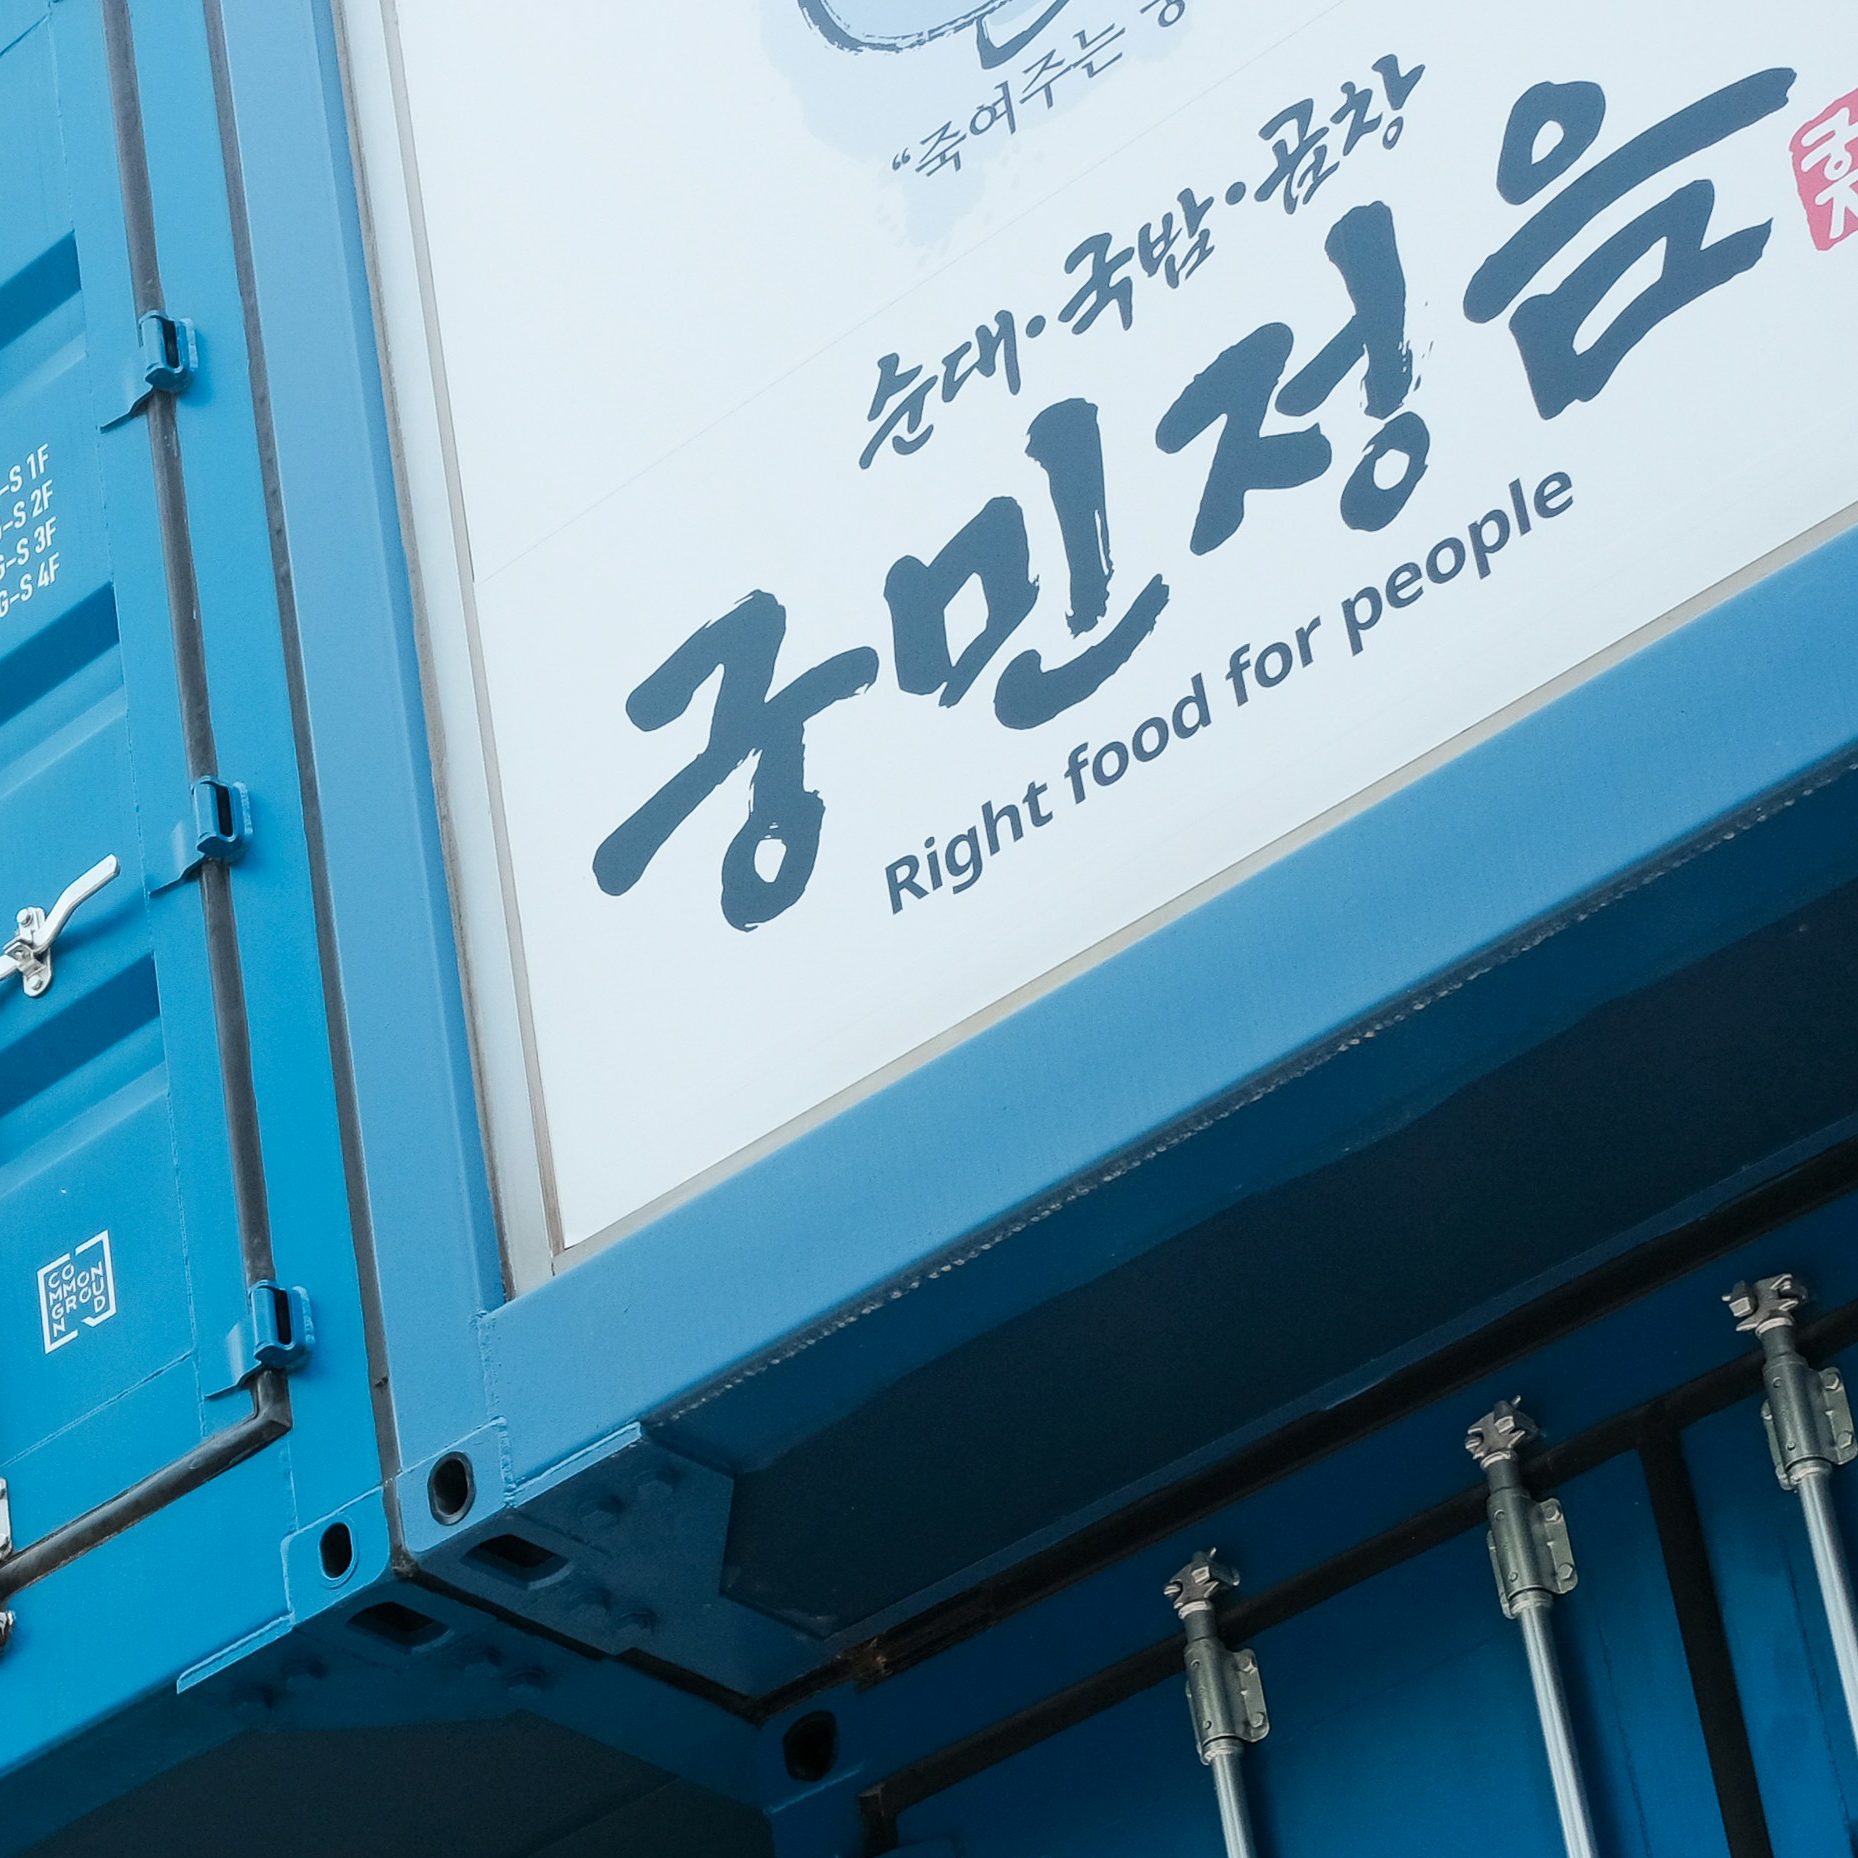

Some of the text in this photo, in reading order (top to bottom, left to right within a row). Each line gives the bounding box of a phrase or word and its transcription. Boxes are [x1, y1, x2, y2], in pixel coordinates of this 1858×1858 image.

[26, 443, 49, 481] 1F
[30, 479, 54, 519] 2F
[33, 515, 57, 554] 3F
[37, 552, 61, 589] 4F
[883, 470, 1575, 915] Right food for people
